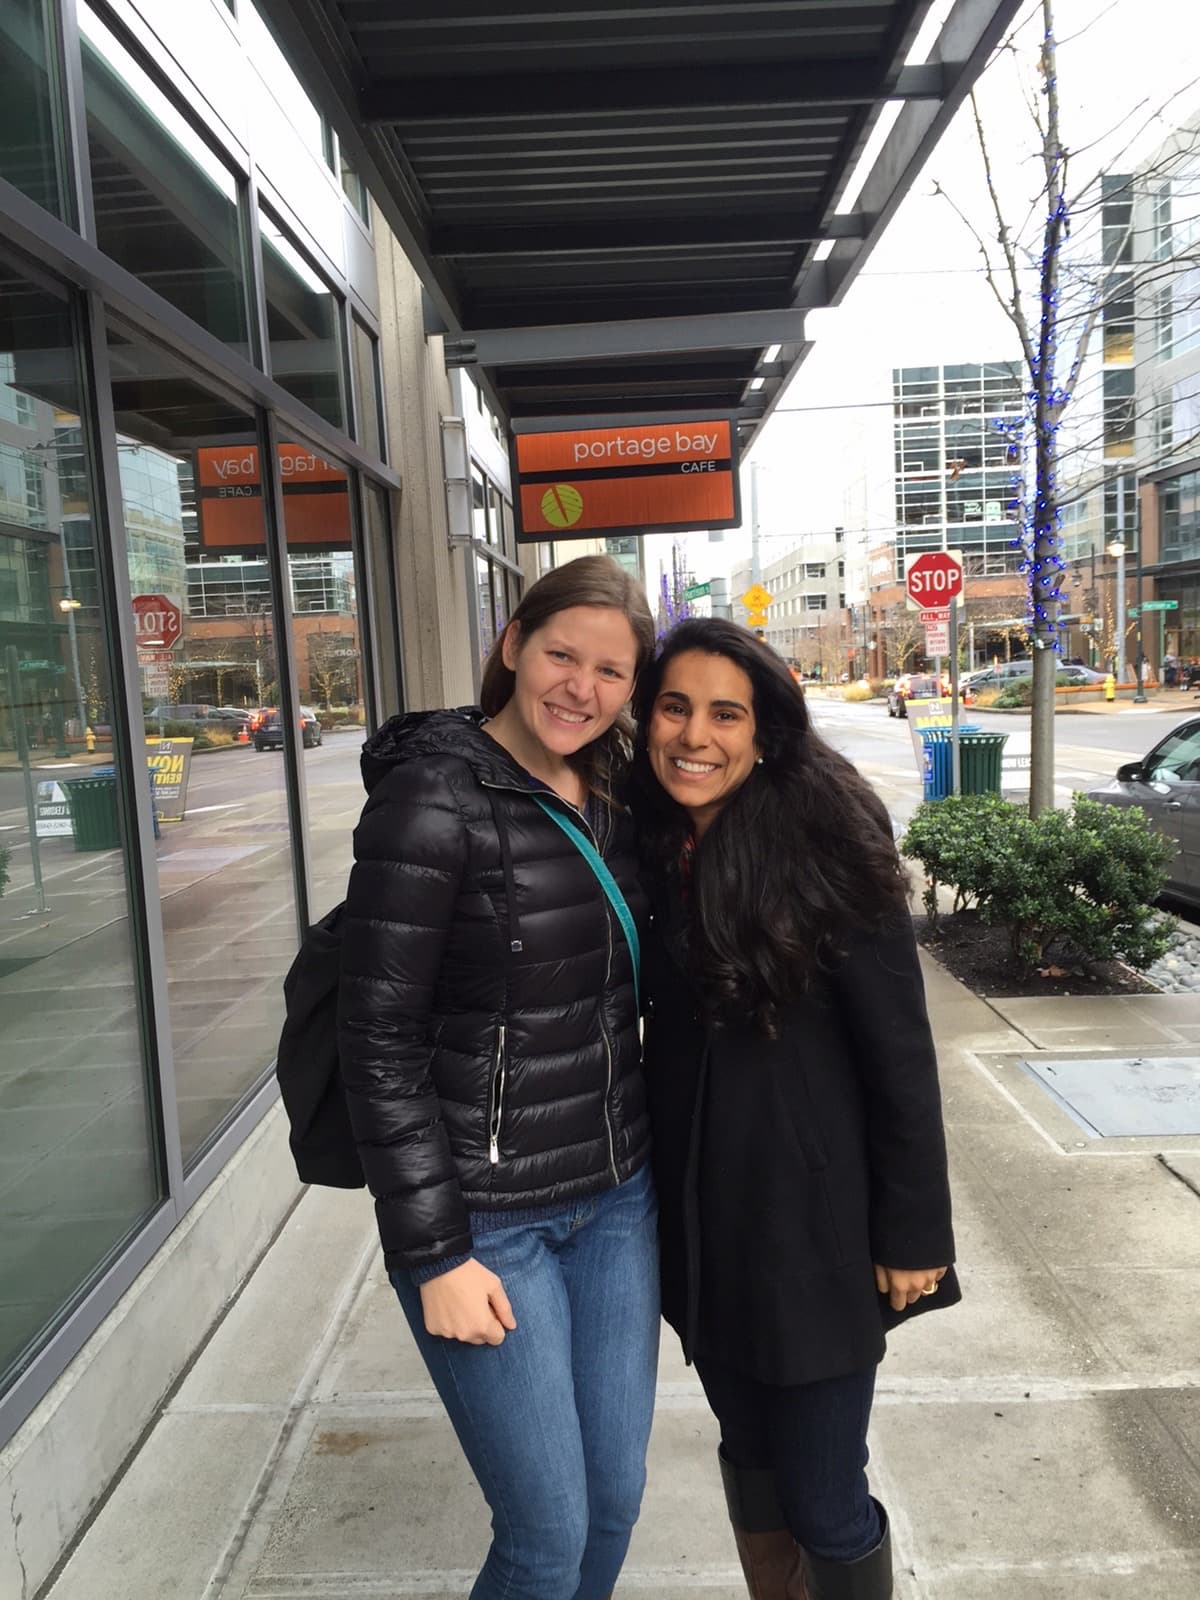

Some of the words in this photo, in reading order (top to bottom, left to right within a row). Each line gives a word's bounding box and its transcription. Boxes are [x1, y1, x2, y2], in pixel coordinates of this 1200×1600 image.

[573, 436, 671, 462] portage
[675, 431, 718, 454] bay
[681, 461, 716, 474] CAFE
[911, 568, 960, 593] STOP
[922, 612, 935, 621] ALL
